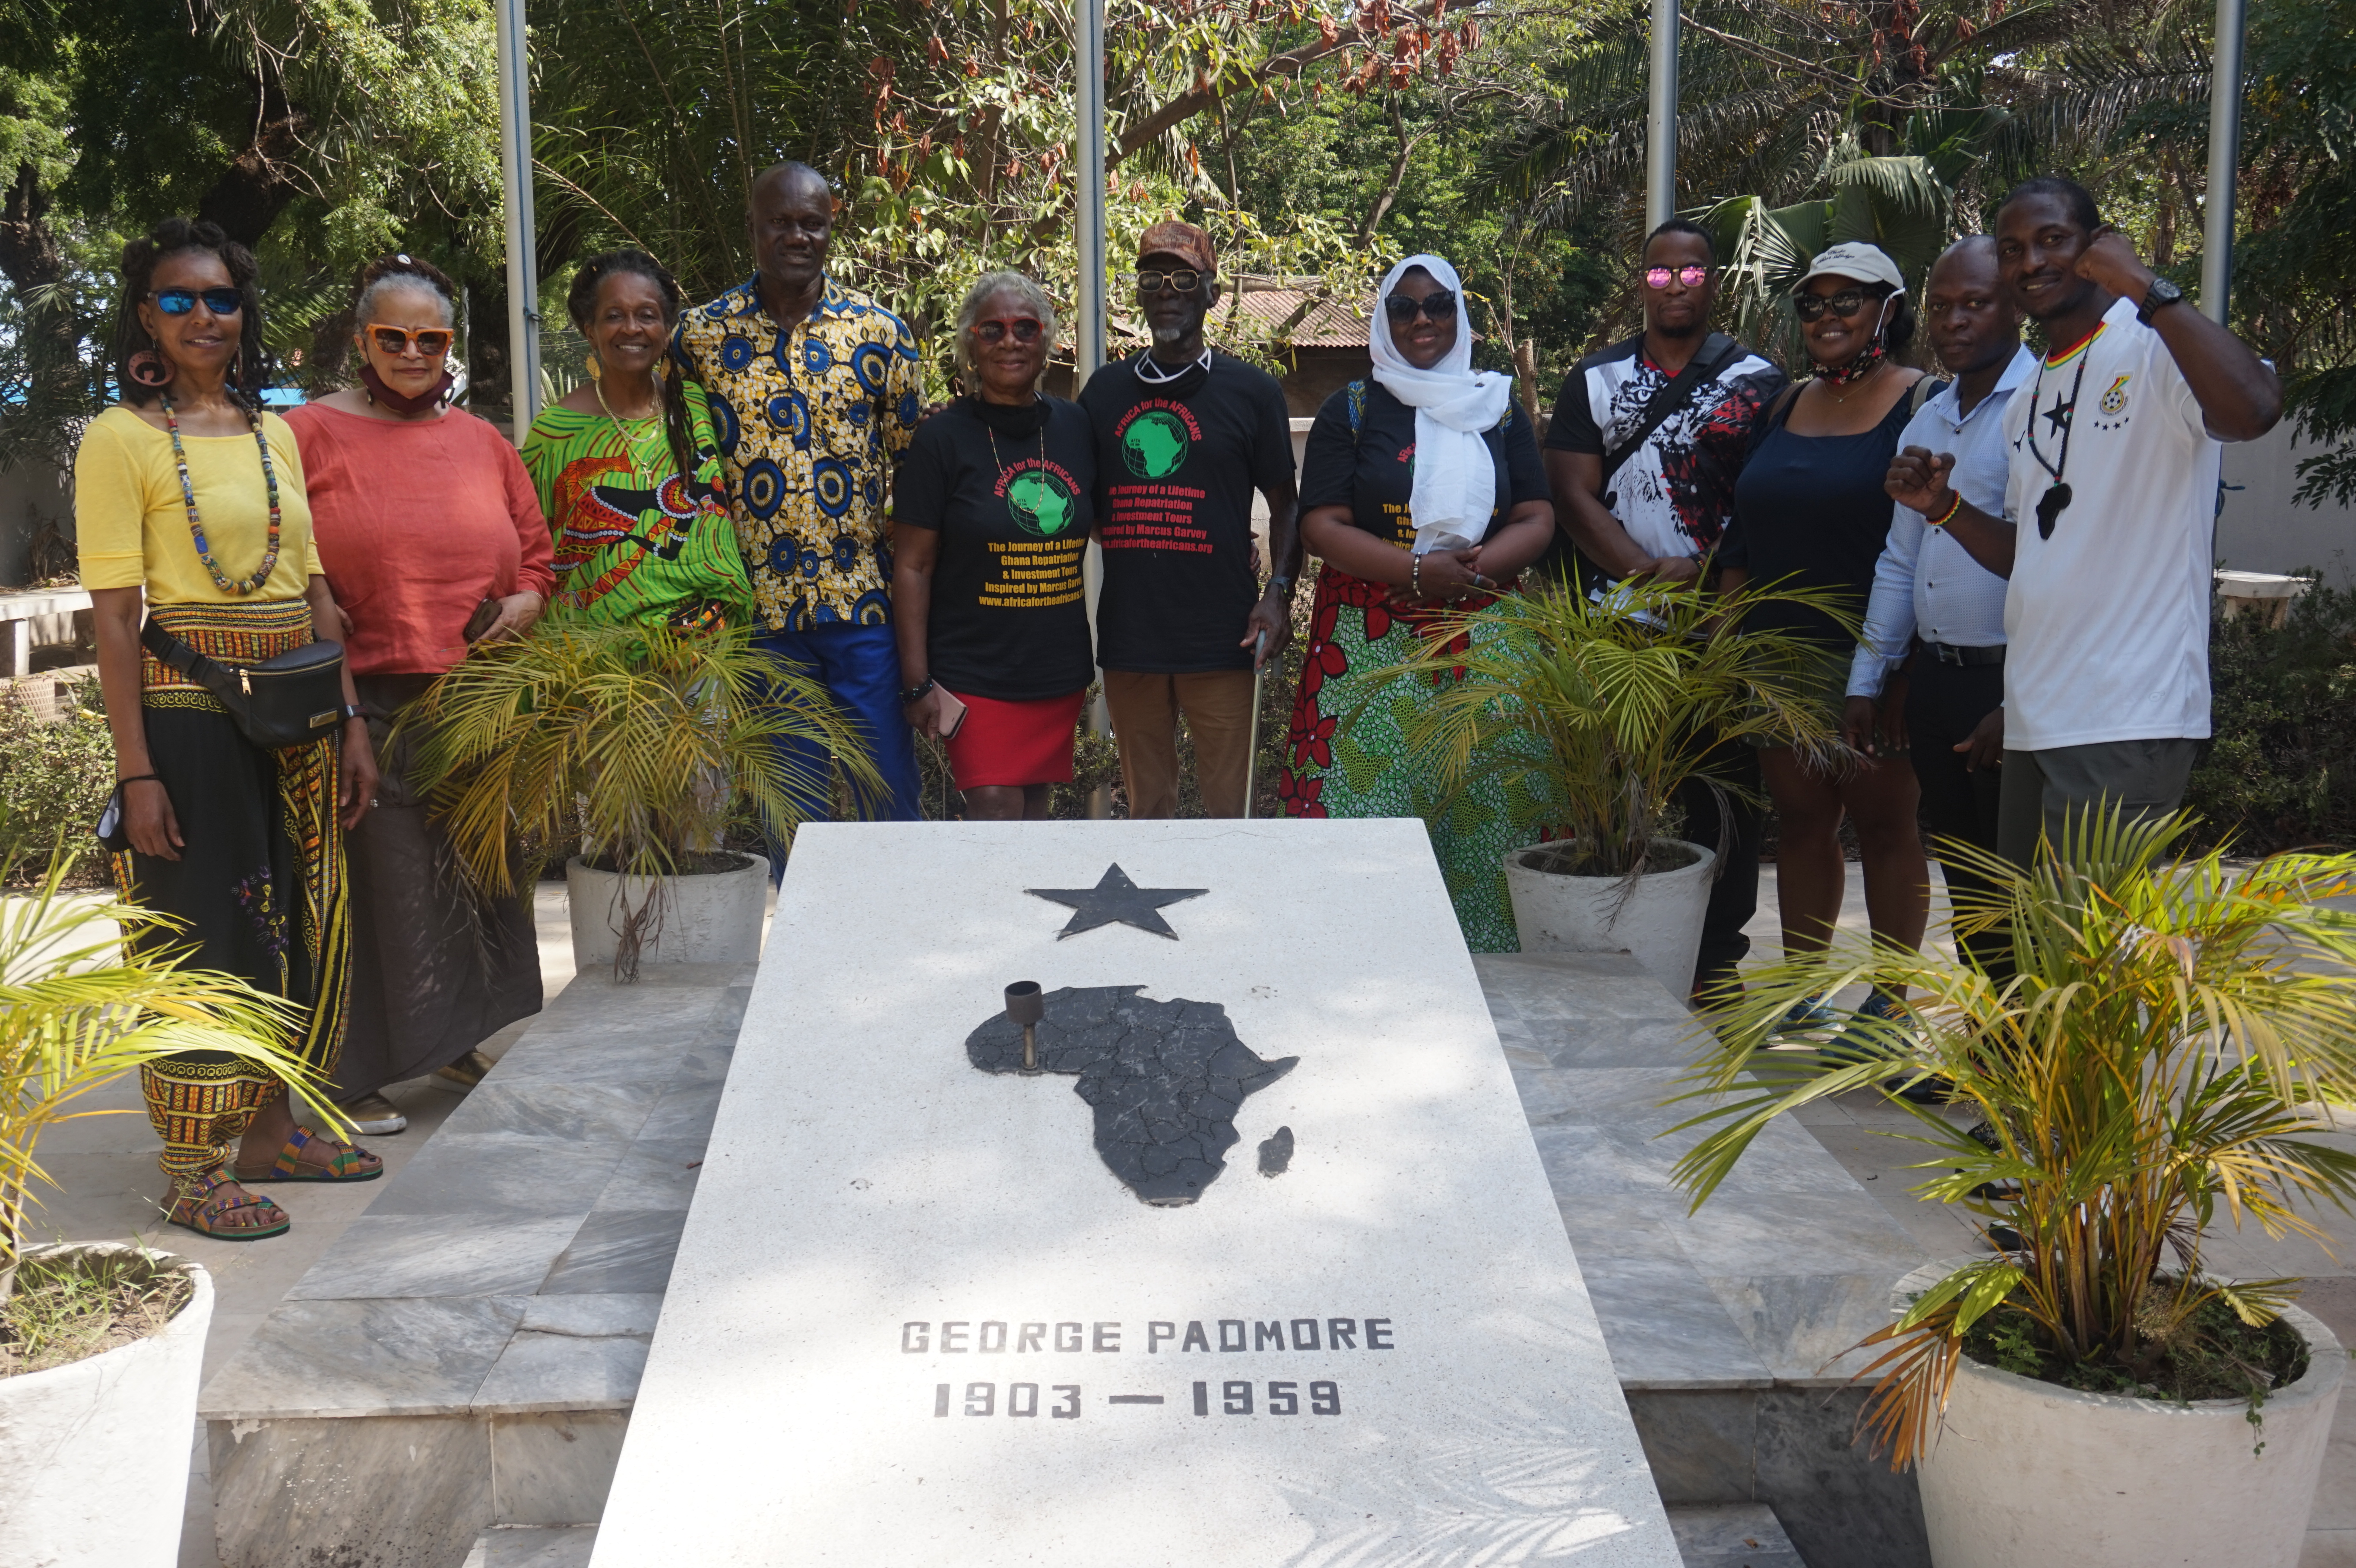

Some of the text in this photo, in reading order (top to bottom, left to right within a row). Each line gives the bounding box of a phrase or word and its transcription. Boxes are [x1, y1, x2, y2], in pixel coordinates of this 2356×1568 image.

[1115, 397, 1202, 441] AFRICA for the AFRICANS
[1013, 461, 1026, 471] for
[1026, 458, 1041, 468] the
[1044, 459, 1081, 495] AFRICANS
[1118, 485, 1148, 495] Journey
[1149, 484, 1159, 494] of
[1160, 486, 1165, 495] a
[1167, 485, 1206, 499] Lifetime
[1112, 497, 1193, 510] Ghana Repatriation
[1383, 503, 1401, 513] The
[1116, 511, 1163, 522] Investment
[1165, 512, 1192, 524] Tours
[1125, 525, 1135, 535] by
[1137, 524, 1172, 536] Marcus
[1174, 526, 1207, 540] Garvey
[1397, 529, 1404, 537] &
[988, 542, 1006, 552] The
[1008, 542, 1043, 552] Journey
[1045, 541, 1054, 551] of
[1055, 542, 1061, 550] a
[1001, 552, 1079, 566] Ghana Repatriation
[1002, 565, 1077, 579] & Investment Tours
[985, 582, 1025, 594] Inspired
[1027, 583, 1038, 594] by
[1039, 581, 1067, 593] Marcus
[901, 1318, 1395, 1354] GEORGE PADMORE
[934, 1381, 1081, 1419] 1903
[1193, 1381, 1341, 1416] 1959
